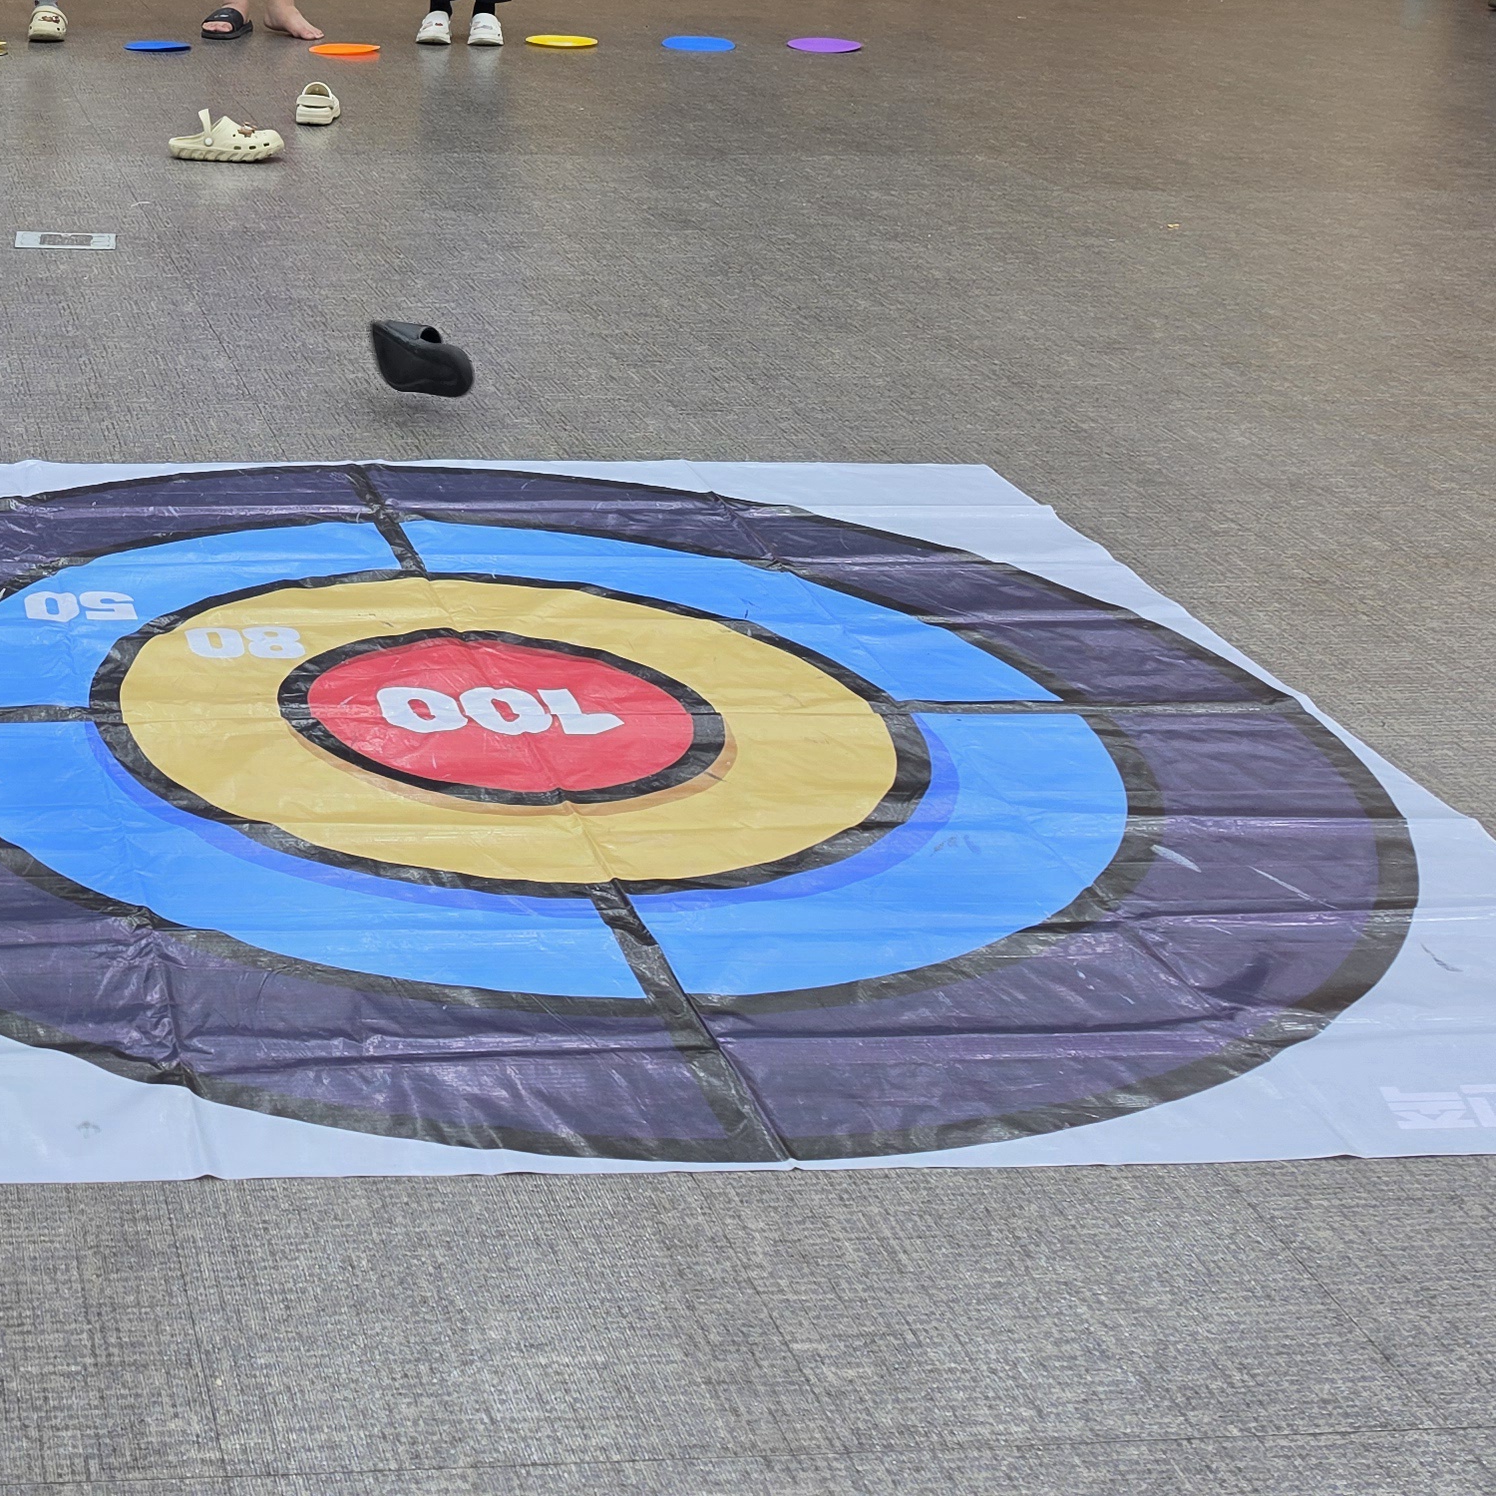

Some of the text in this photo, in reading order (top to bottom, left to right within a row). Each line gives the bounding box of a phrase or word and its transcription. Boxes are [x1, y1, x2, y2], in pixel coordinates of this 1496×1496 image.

[25, 590, 138, 622] 50
[184, 627, 306, 659] 80
[376, 686, 625, 736] 100
